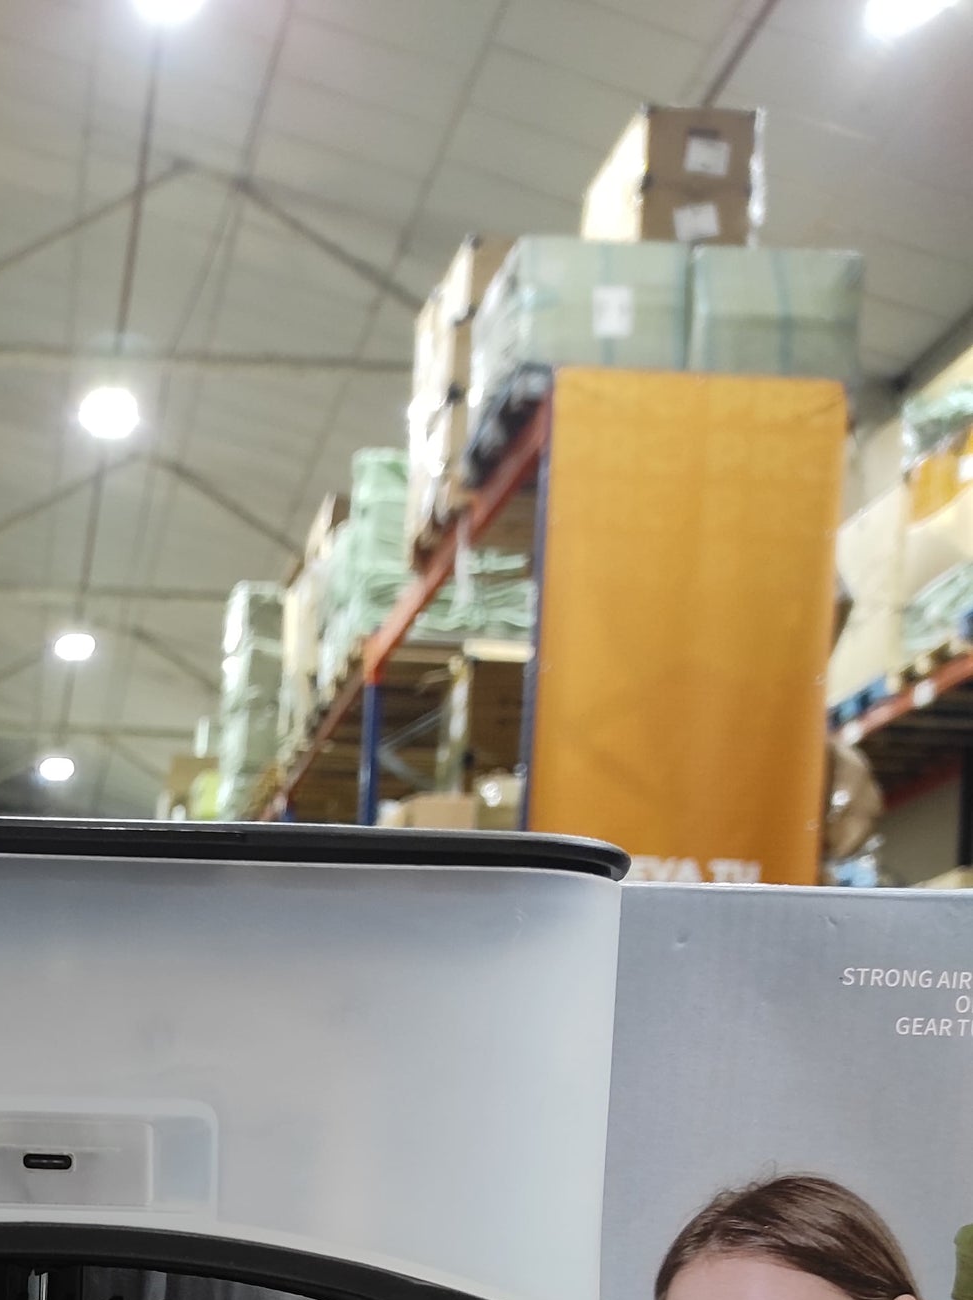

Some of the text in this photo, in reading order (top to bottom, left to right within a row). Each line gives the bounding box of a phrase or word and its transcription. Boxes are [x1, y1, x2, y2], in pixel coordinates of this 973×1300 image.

[842, 967, 973, 990] STRONG AIR
[955, 995, 973, 1014] O
[895, 1016, 973, 1037] GEAR T
